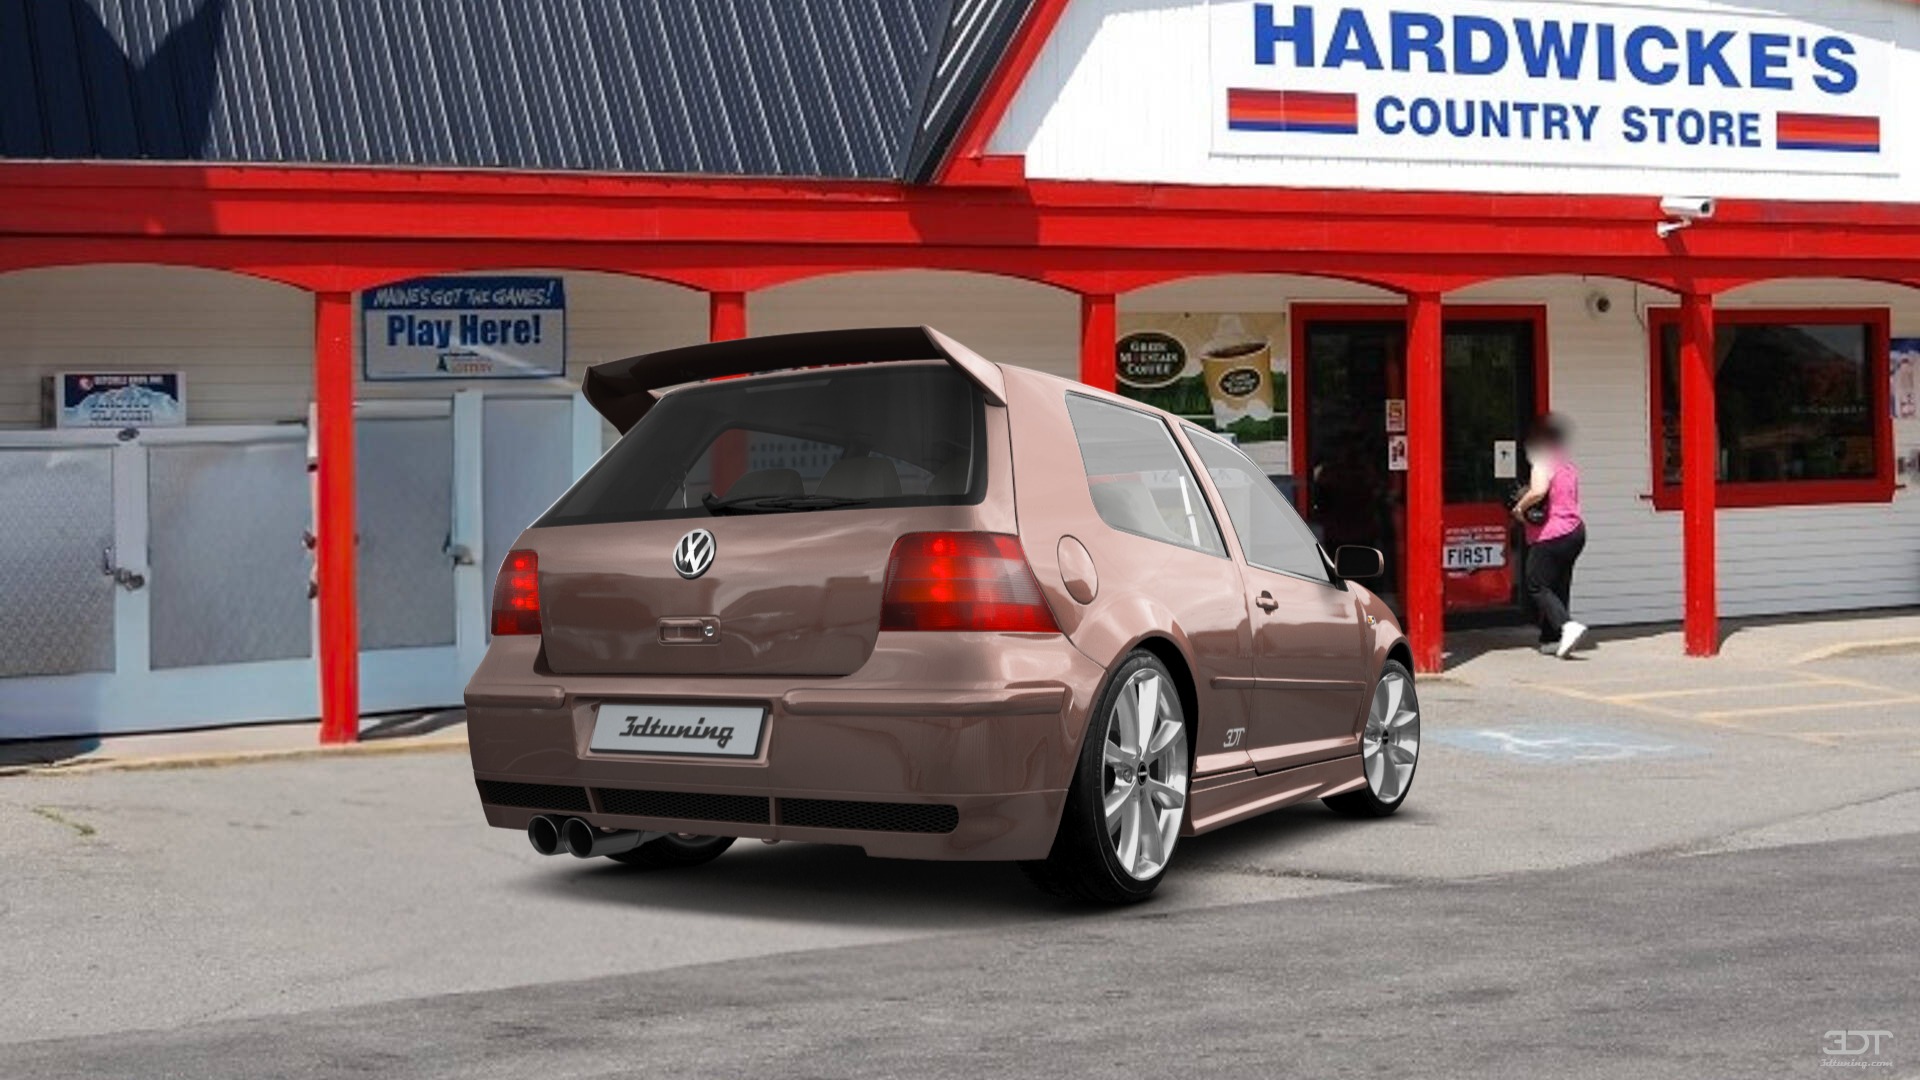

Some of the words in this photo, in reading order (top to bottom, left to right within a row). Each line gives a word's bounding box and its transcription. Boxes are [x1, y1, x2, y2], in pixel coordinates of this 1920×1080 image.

[1253, 2, 1859, 95] HARDWICKE'S
[1374, 96, 1600, 142] COUNTRY
[1622, 106, 1762, 148] STORE
[373, 286, 430, 308] MAINE'S
[431, 287, 464, 306] GOT
[491, 280, 556, 307] GAMES!
[387, 314, 452, 348] Play
[459, 314, 542, 345] Here!
[1448, 546, 1494, 566] FIRST
[619, 715, 735, 749] 3dtuning
